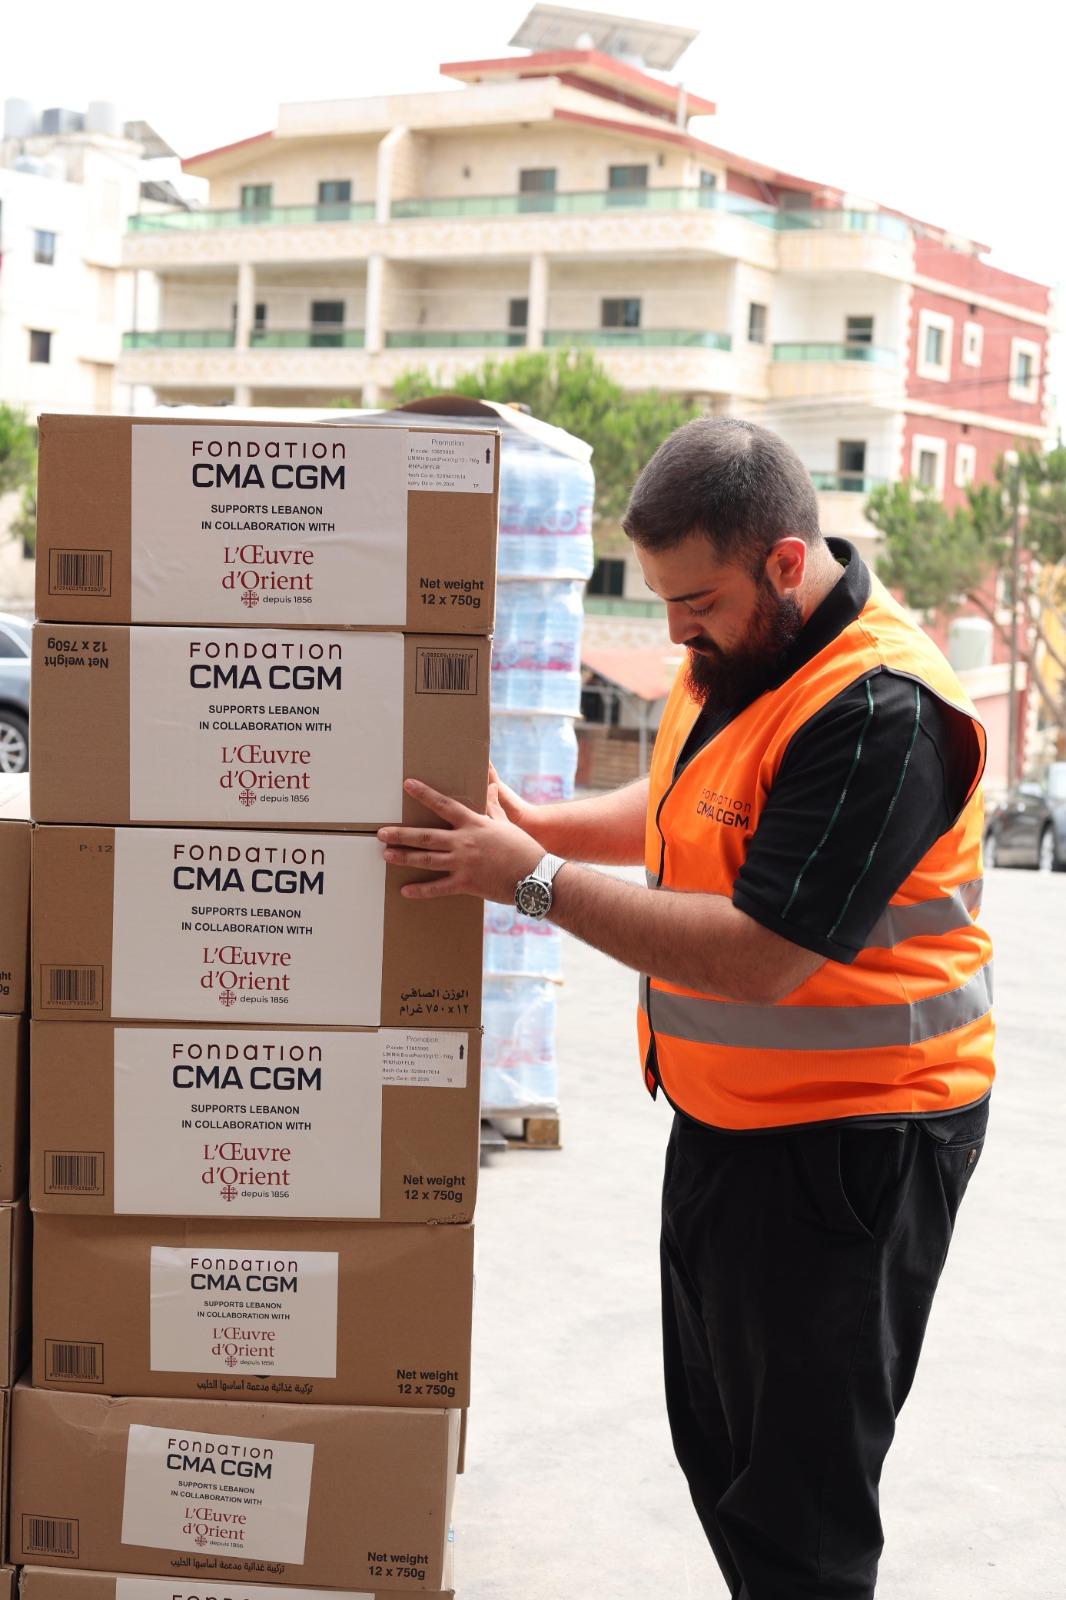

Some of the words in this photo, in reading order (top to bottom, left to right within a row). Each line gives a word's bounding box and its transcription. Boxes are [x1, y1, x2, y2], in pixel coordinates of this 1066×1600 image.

[193, 464, 265, 488] CMA
[272, 465, 345, 489] CGM
[211, 505, 268, 514] SUPPORTS
[272, 506, 322, 514] LEBANON
[202, 521, 211, 529] IN
[215, 521, 305, 531] COLLABORATION
[309, 523, 334, 531] WITH
[420, 578, 440, 589] Net
[444, 579, 484, 592] weight
[263, 596, 291, 604] depuis
[421, 594, 435, 604] 12
[439, 597, 447, 605] x
[451, 595, 480, 608] 750g
[48, 638, 78, 651] 750g
[93, 642, 107, 652] 12
[45, 654, 84, 667] weight
[88, 658, 108, 668] Net
[190, 665, 262, 689] CMA
[269, 666, 341, 690] CGM
[209, 705, 265, 714] SUPPORTS
[269, 706, 319, 714] LEBANON
[200, 721, 209, 729] IN
[213, 722, 302, 731] COLLABORATION
[305, 723, 331, 731] WITH
[260, 795, 288, 803] depuis
[697, 801, 714, 820] CMA
[716, 808, 749, 830] CGM
[174, 867, 244, 892] CMA
[252, 869, 324, 894] CGM
[192, 906, 247, 916] SUPPORTS
[251, 909, 301, 918] LEBANON
[182, 922, 191, 930] IN
[195, 923, 283, 933] COLLABORATION
[287, 926, 312, 934] WITH
[240, 996, 268, 1004] depuis
[401, 988, 439, 1001] الصافي
[443, 989, 468, 1000] الوزن
[400, 1004, 423, 1016] غرام
[173, 1065, 243, 1089] CMA
[250, 1067, 321, 1090] CGM
[191, 1105, 246, 1113] SUPPORTS
[250, 1106, 299, 1114] LEBANON
[182, 1120, 191, 1128] IN
[195, 1121, 282, 1129] COLLABORATION
[286, 1122, 311, 1130] WITH
[404, 1175, 423, 1185] Net
[427, 1176, 465, 1188] weight
[241, 1190, 269, 1198] depuis
[404, 1190, 418, 1199] 12
[433, 1190, 462, 1203] 750g
[191, 1274, 241, 1291] CMA
[246, 1276, 297, 1292] CGM
[397, 1370, 416, 1379] Net
[420, 1371, 458, 1382] weight
[398, 1384, 411, 1394] 12
[415, 1386, 422, 1394] x
[426, 1385, 455, 1397] 750g
[167, 1454, 216, 1474] CMA
[221, 1460, 271, 1479] CGM
[178, 1481, 217, 1490] SUPPORTS
[220, 1485, 254, 1494] LEBANON
[180, 1491, 241, 1503] COLLABORATION
[368, 1552, 387, 1562] Net
[390, 1554, 428, 1565] weight
[369, 1566, 382, 1576] 12
[397, 1568, 425, 1580] 750g
